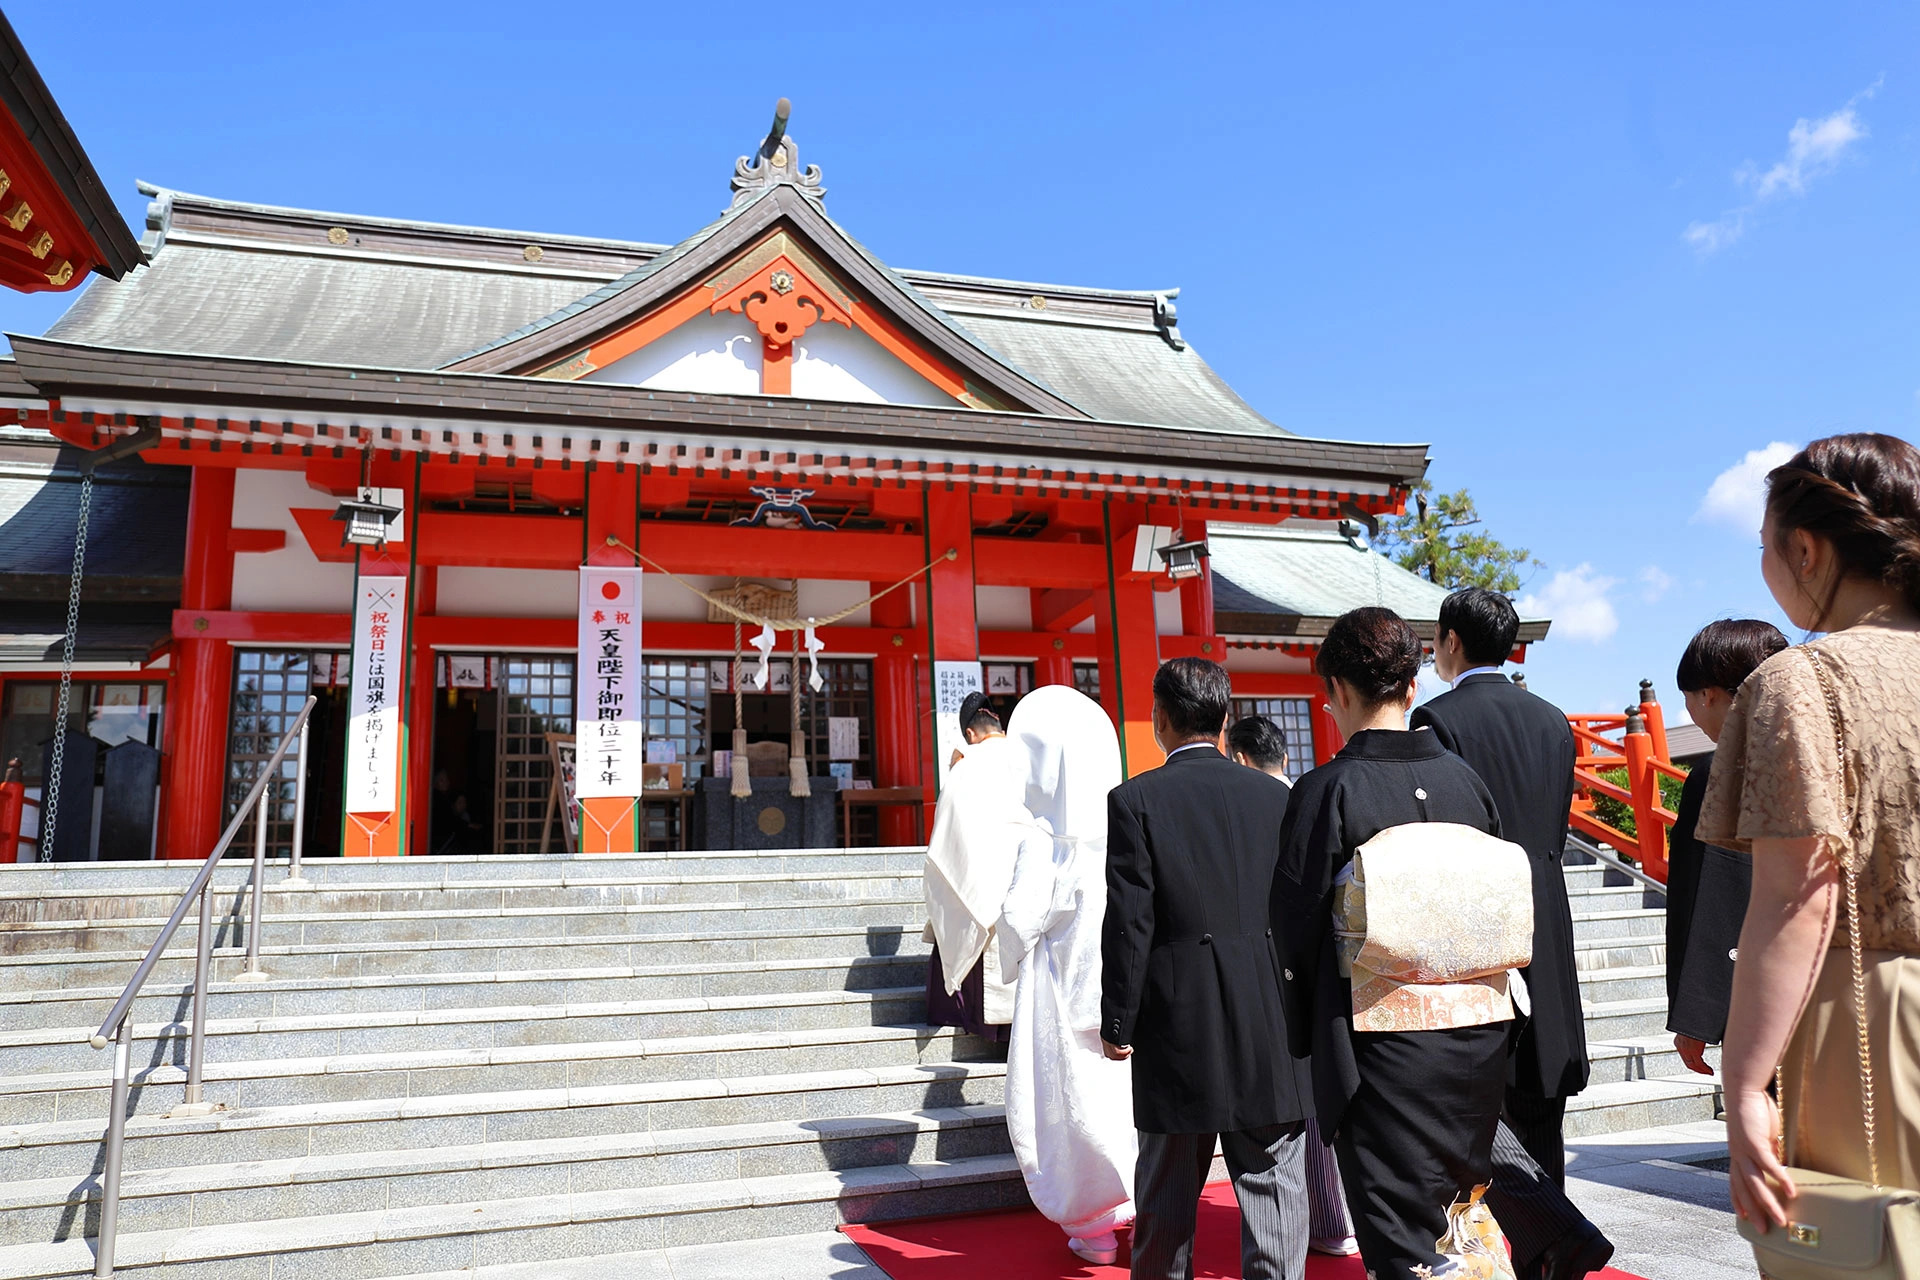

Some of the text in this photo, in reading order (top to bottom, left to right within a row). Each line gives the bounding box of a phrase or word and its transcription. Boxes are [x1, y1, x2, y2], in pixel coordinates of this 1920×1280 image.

[591, 610, 631, 625] 奉祝
[365, 610, 389, 799] 祝祭日には国旗を掲げましょう
[597, 628, 624, 786] 天皇陛下御即位三十年
